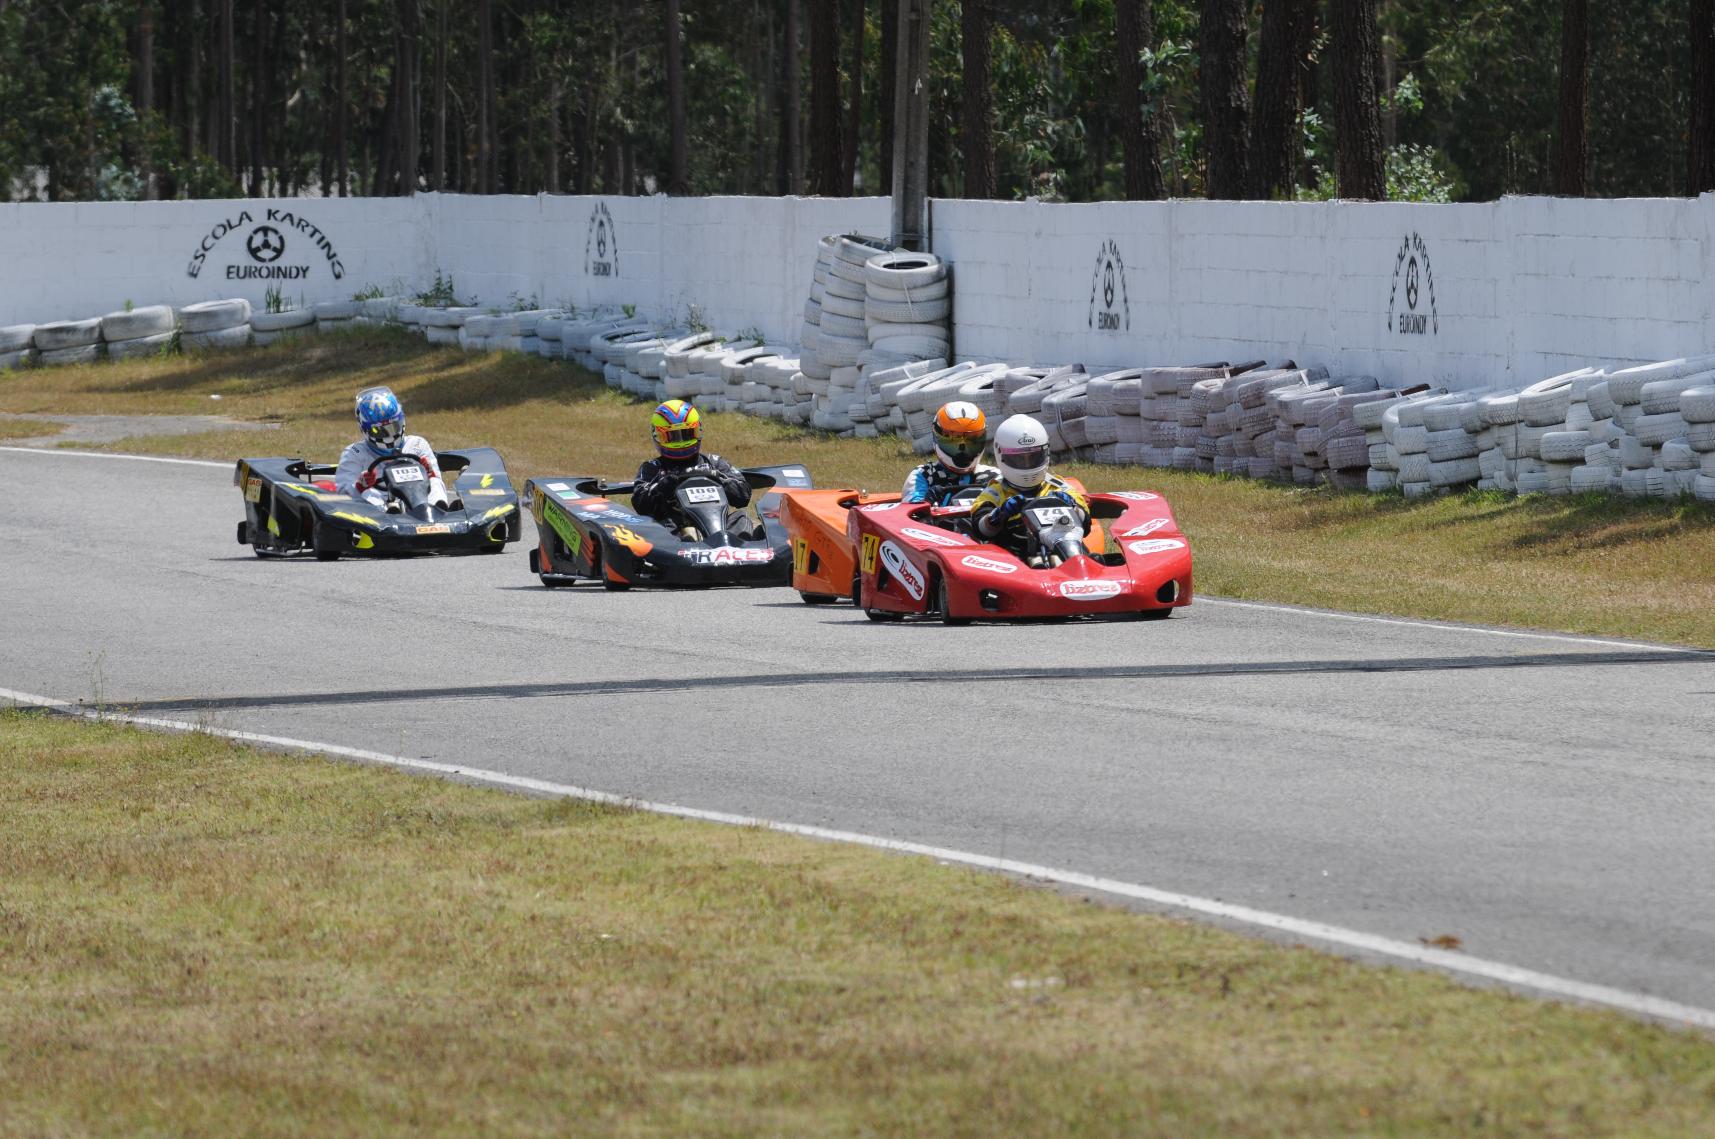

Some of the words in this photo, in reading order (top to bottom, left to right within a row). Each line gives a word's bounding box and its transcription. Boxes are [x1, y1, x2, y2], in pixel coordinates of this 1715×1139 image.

[187, 210, 253, 279] ESCOLA
[267, 208, 346, 280] KARTING
[226, 265, 310, 280] EUROINDY
[1400, 313, 1427, 335] EUROINDY
[863, 536, 877, 571] 74
